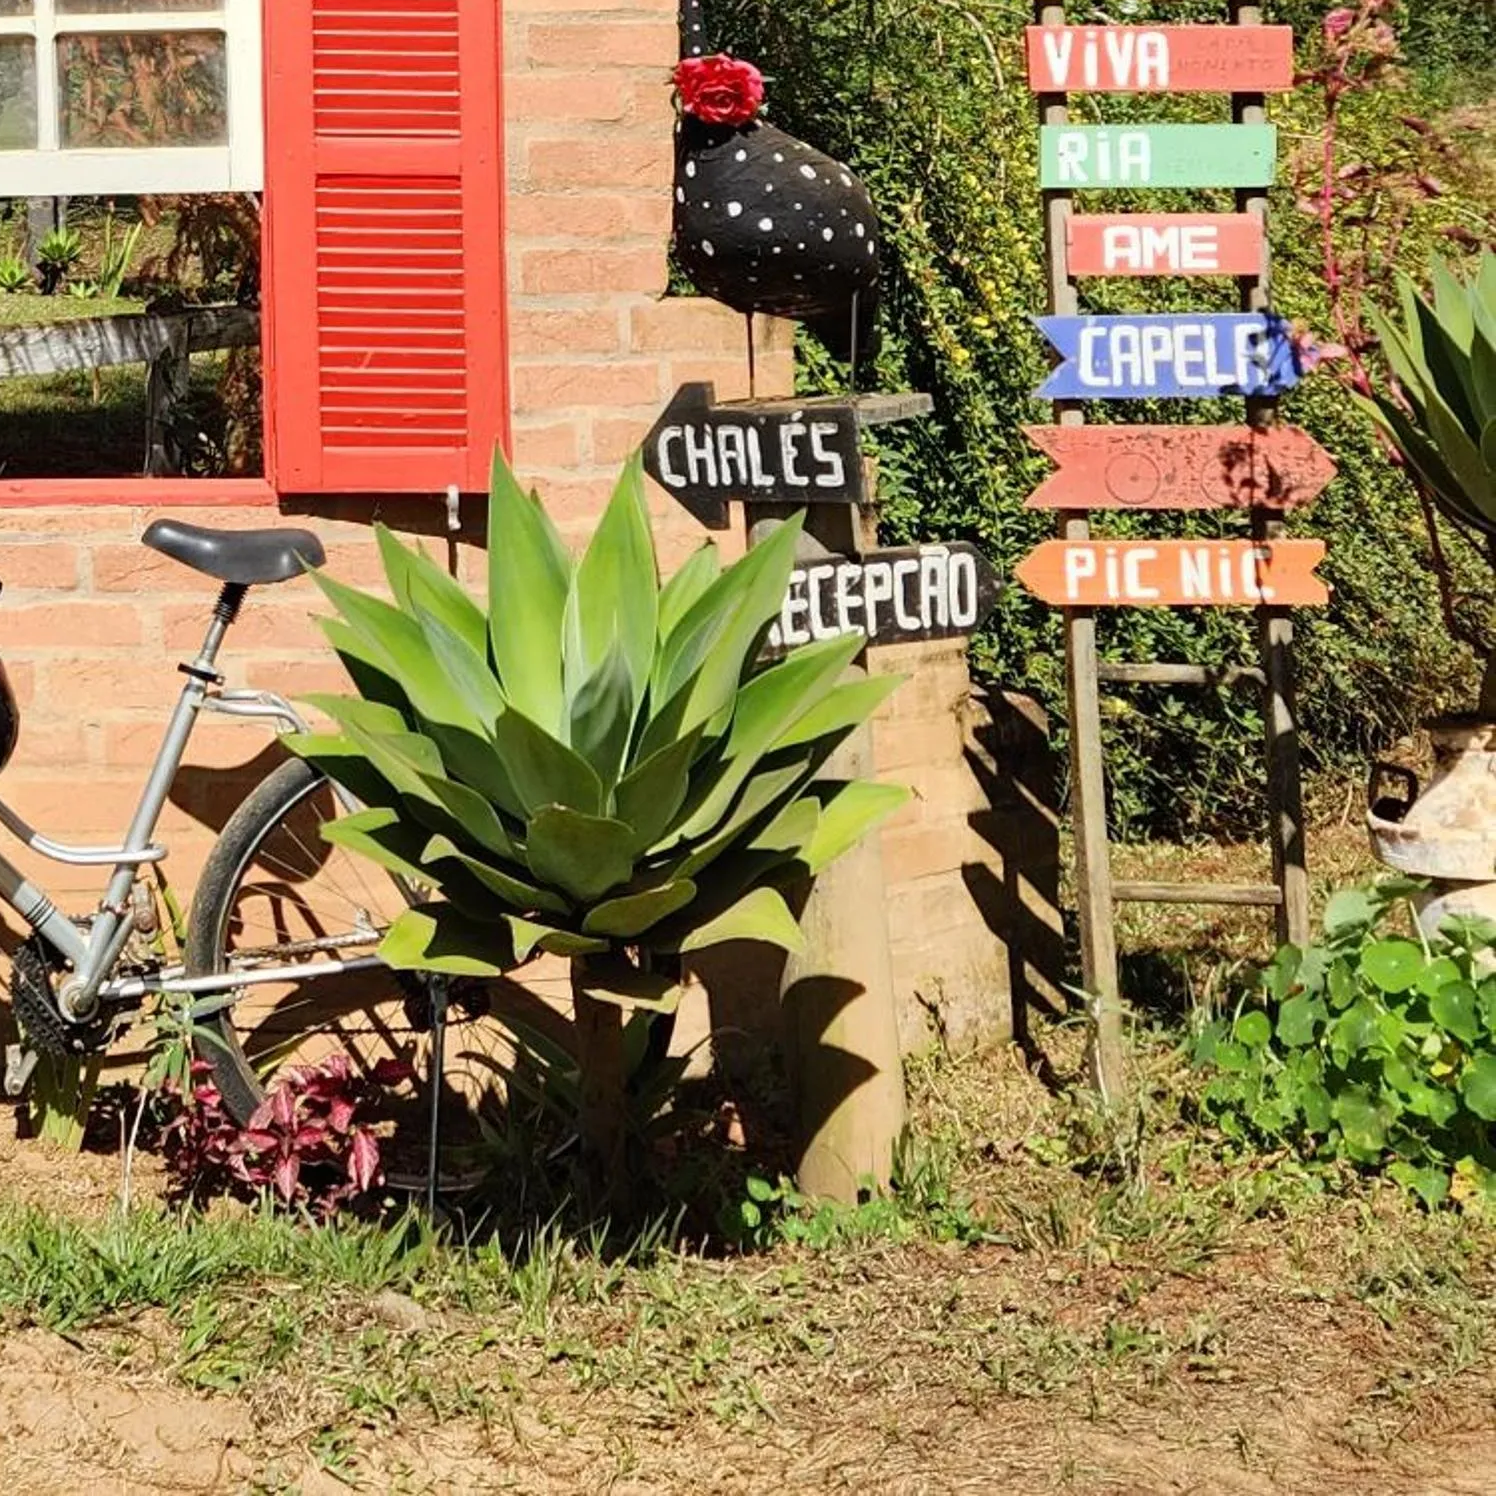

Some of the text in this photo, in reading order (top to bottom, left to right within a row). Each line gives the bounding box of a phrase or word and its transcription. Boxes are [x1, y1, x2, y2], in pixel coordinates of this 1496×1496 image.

[1103, 224, 1219, 270] AME
[1078, 324, 1271, 387] CAPELA
[657, 411, 846, 488] CHALÉS
[768, 545, 978, 647] ECEPCÃO
